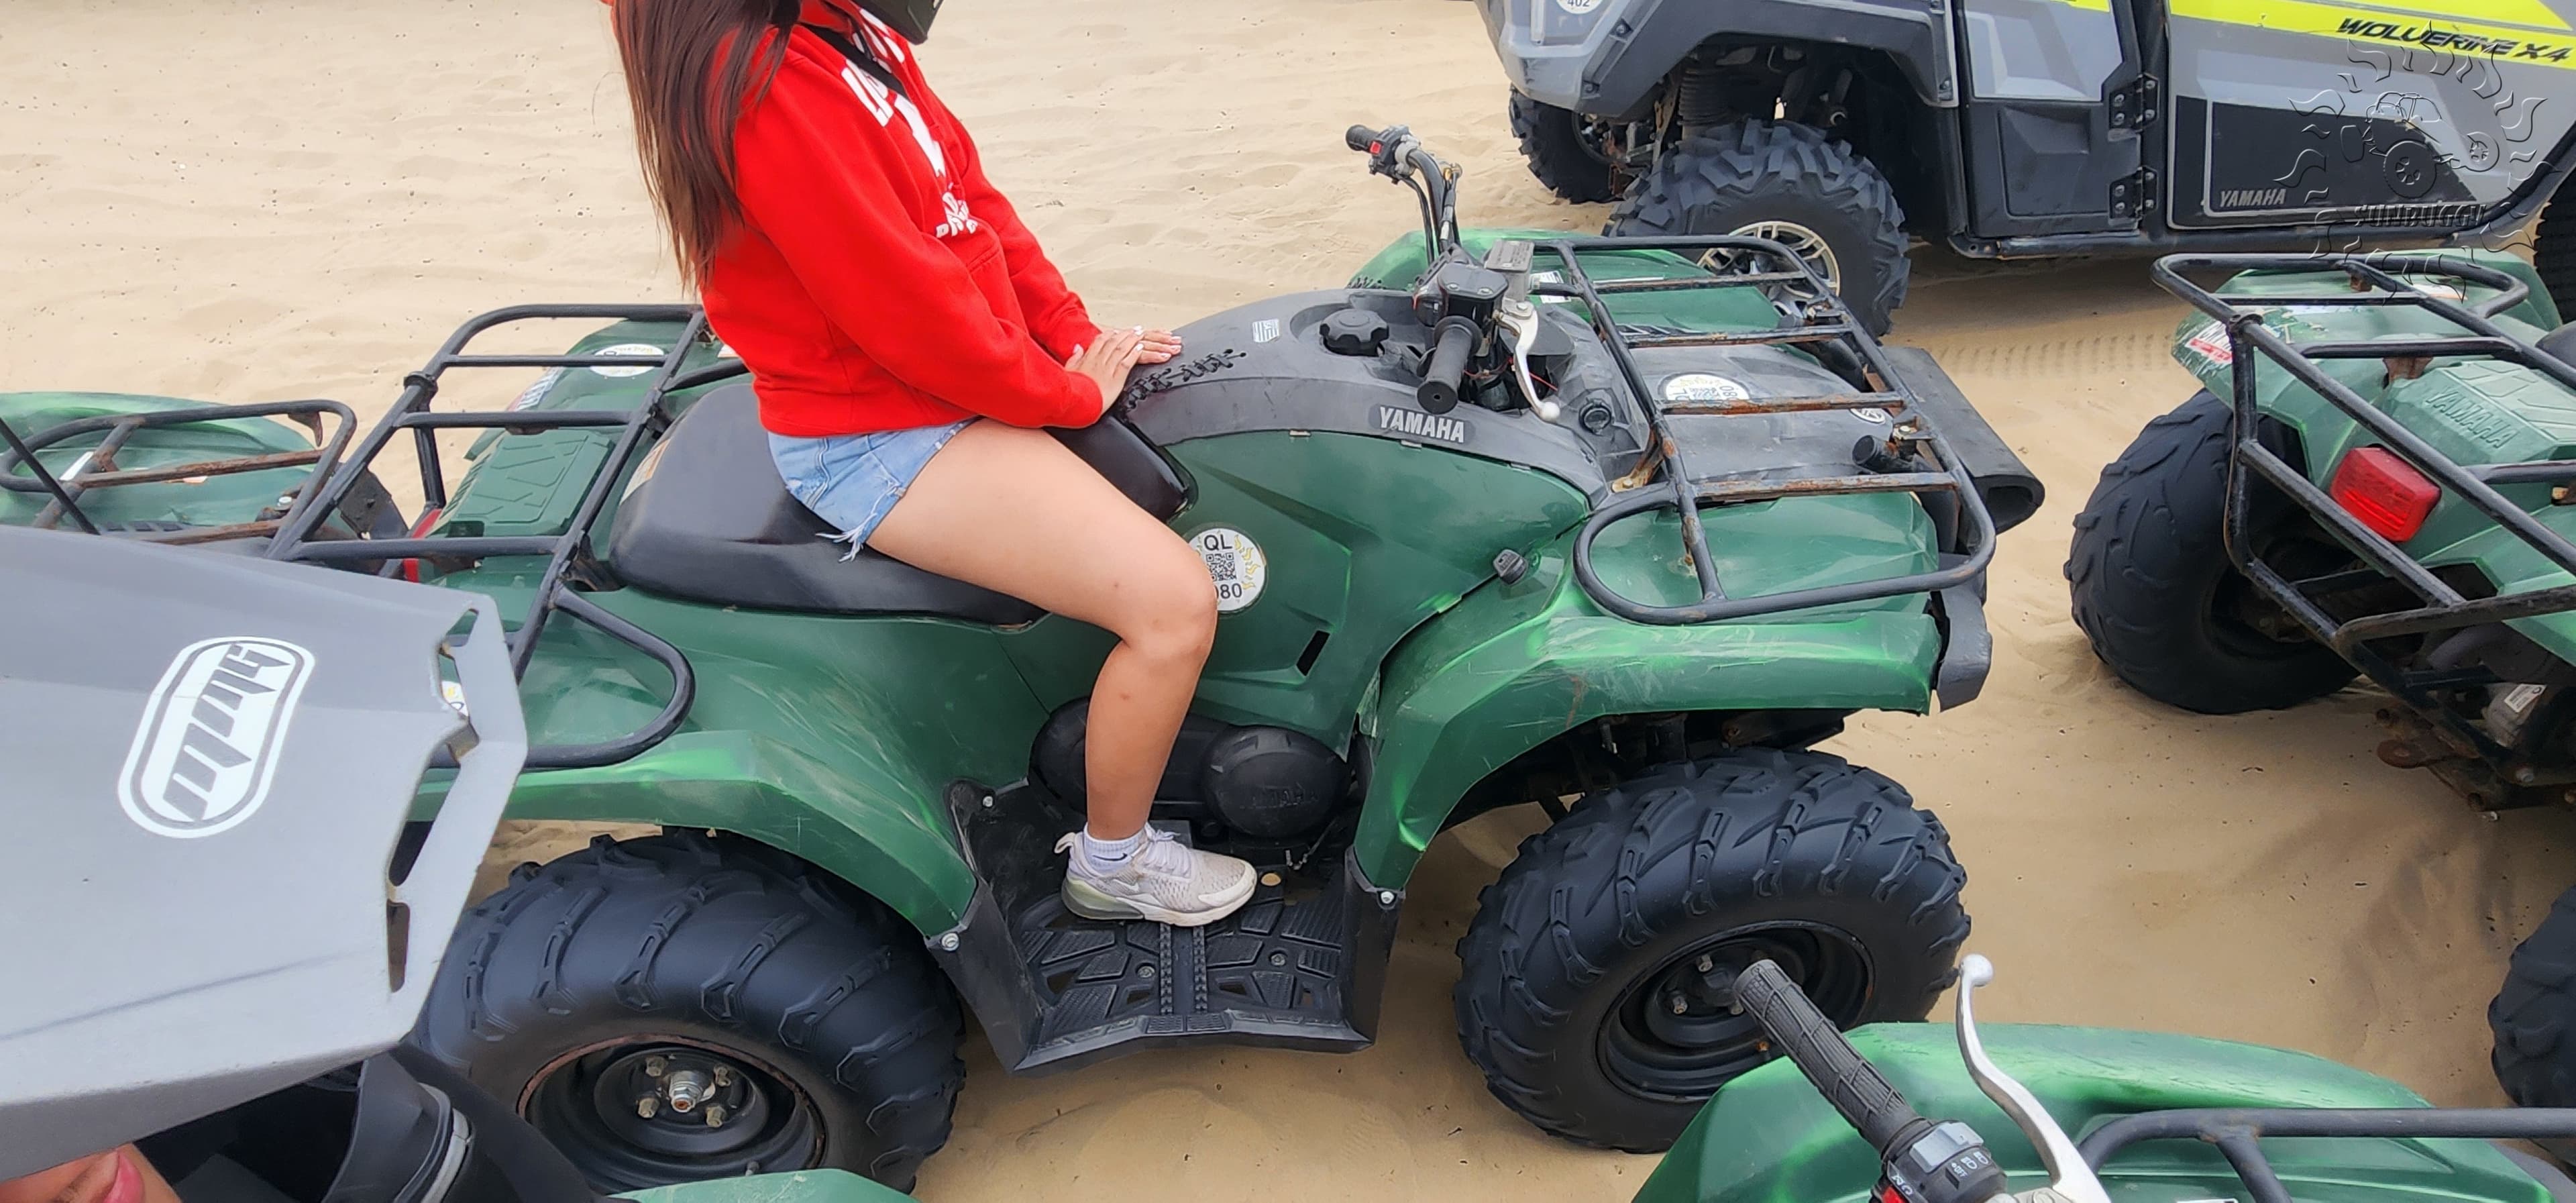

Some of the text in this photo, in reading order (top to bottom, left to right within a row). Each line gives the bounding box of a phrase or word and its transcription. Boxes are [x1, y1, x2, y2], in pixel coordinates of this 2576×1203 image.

[2514, 43, 2574, 62] X4
[2220, 189, 2286, 207] YAMAHA
[1380, 407, 1464, 443] YAMAHA
[2424, 387, 2520, 449] YAMAHA
[1204, 534, 1232, 551] QL
